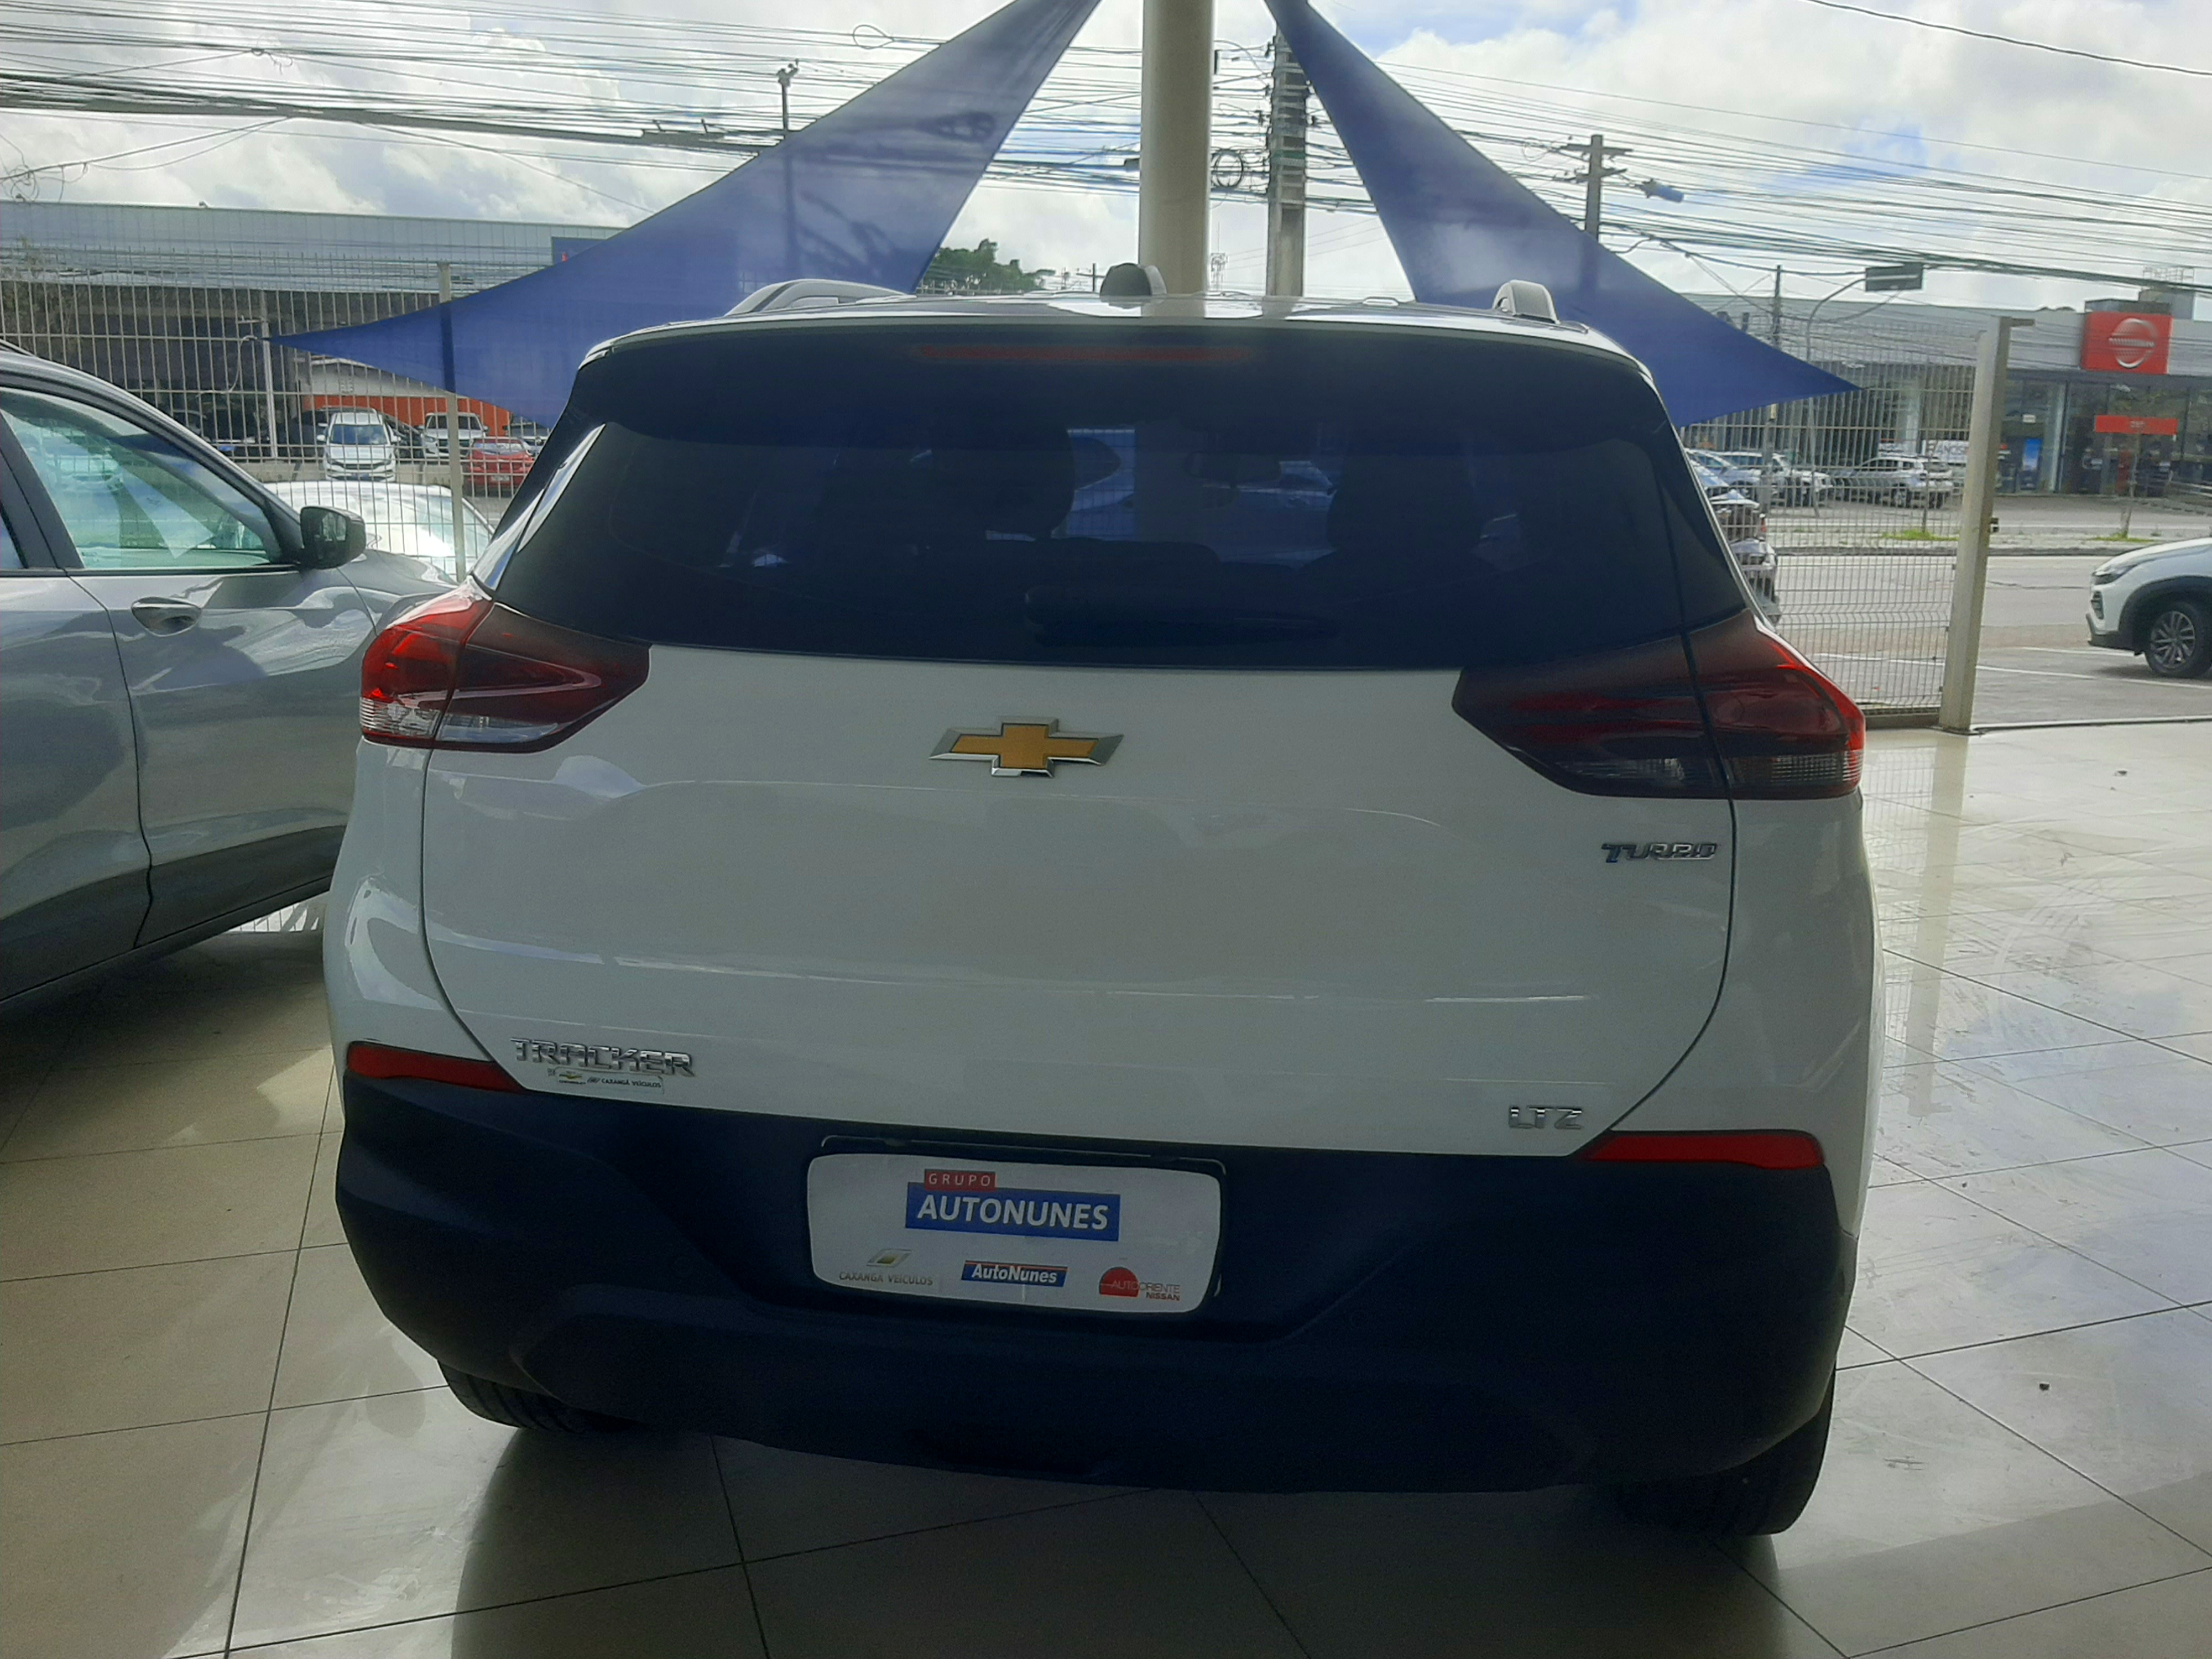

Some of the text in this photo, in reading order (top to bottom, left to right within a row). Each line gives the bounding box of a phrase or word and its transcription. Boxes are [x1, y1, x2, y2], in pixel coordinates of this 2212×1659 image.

[1601, 842, 1717, 863] TURBO
[510, 1037, 695, 1077] TRACKER
[1509, 1105, 1583, 1130] LTZ
[928, 1172, 991, 1187] GRUPO
[916, 1194, 1109, 1230] AUTONUNES
[971, 1263, 1057, 1283] AutoNunes
[1146, 1292, 1180, 1301] NISSAN
